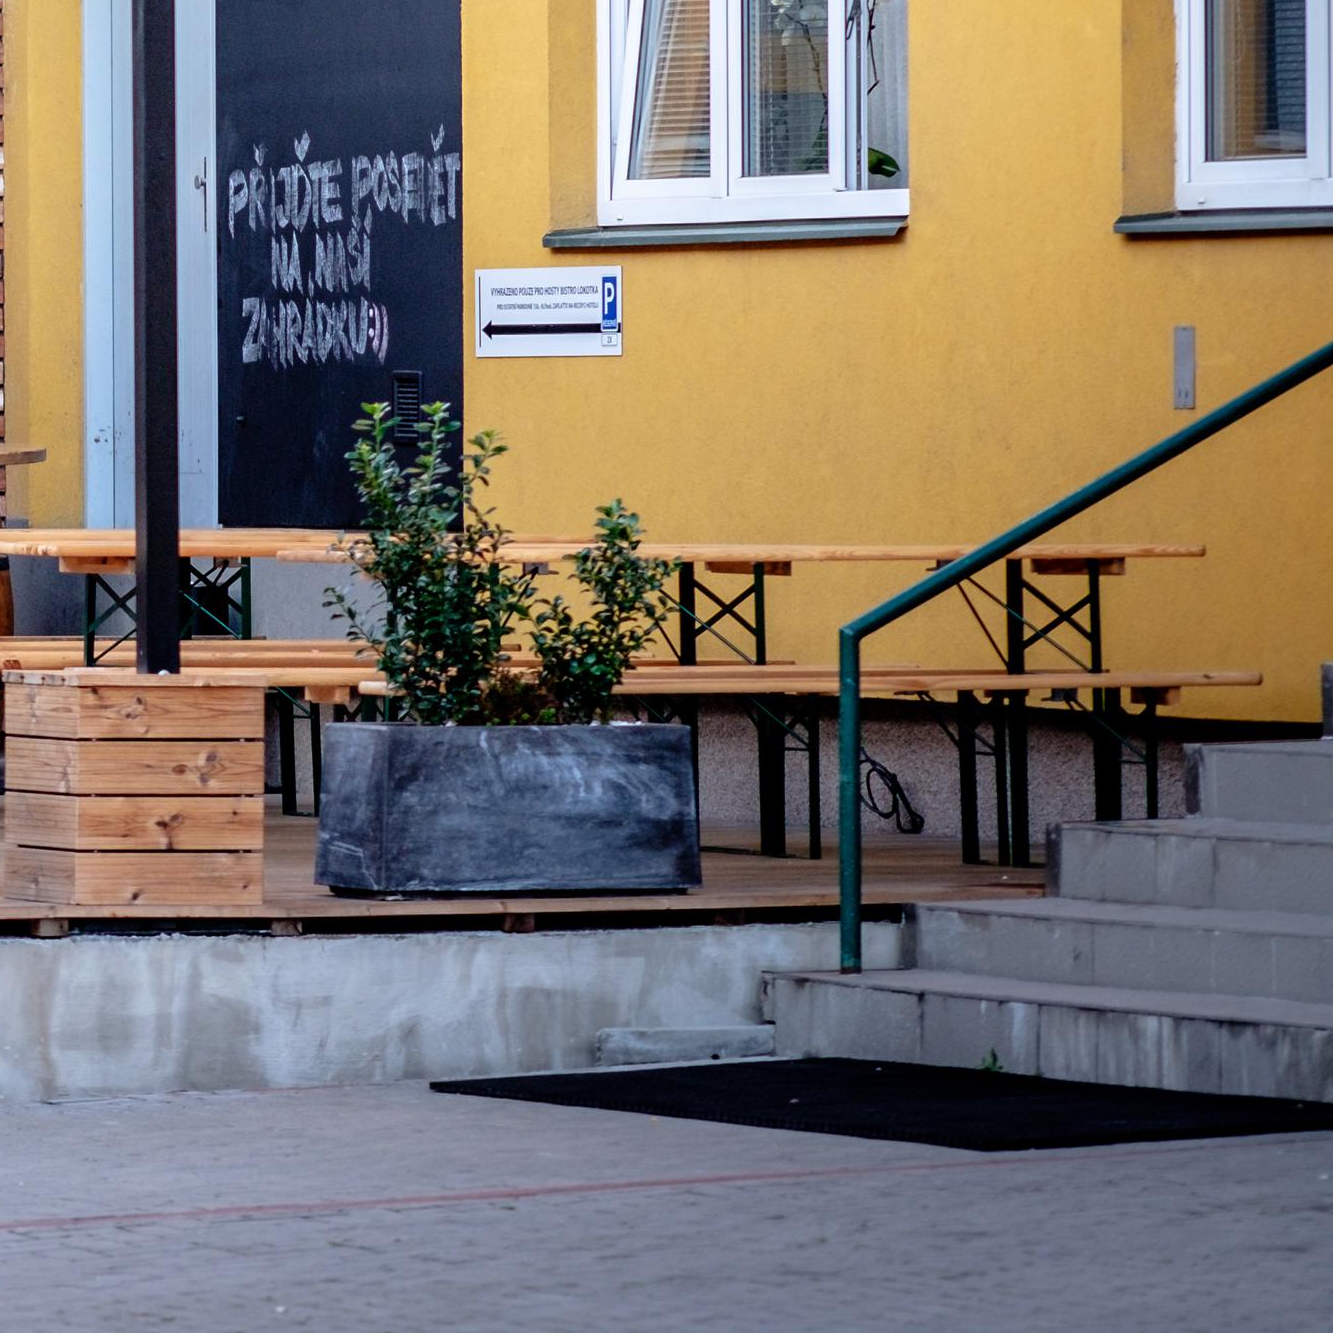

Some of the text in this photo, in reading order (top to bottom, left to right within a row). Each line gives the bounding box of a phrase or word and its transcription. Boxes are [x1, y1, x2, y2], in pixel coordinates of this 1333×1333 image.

[271, 230, 304, 295] NA
[490, 285, 599, 296] VYHRAZENO POUZE PRO HOSTY BISTRO LOKOTKA
[604, 282, 615, 315] P
